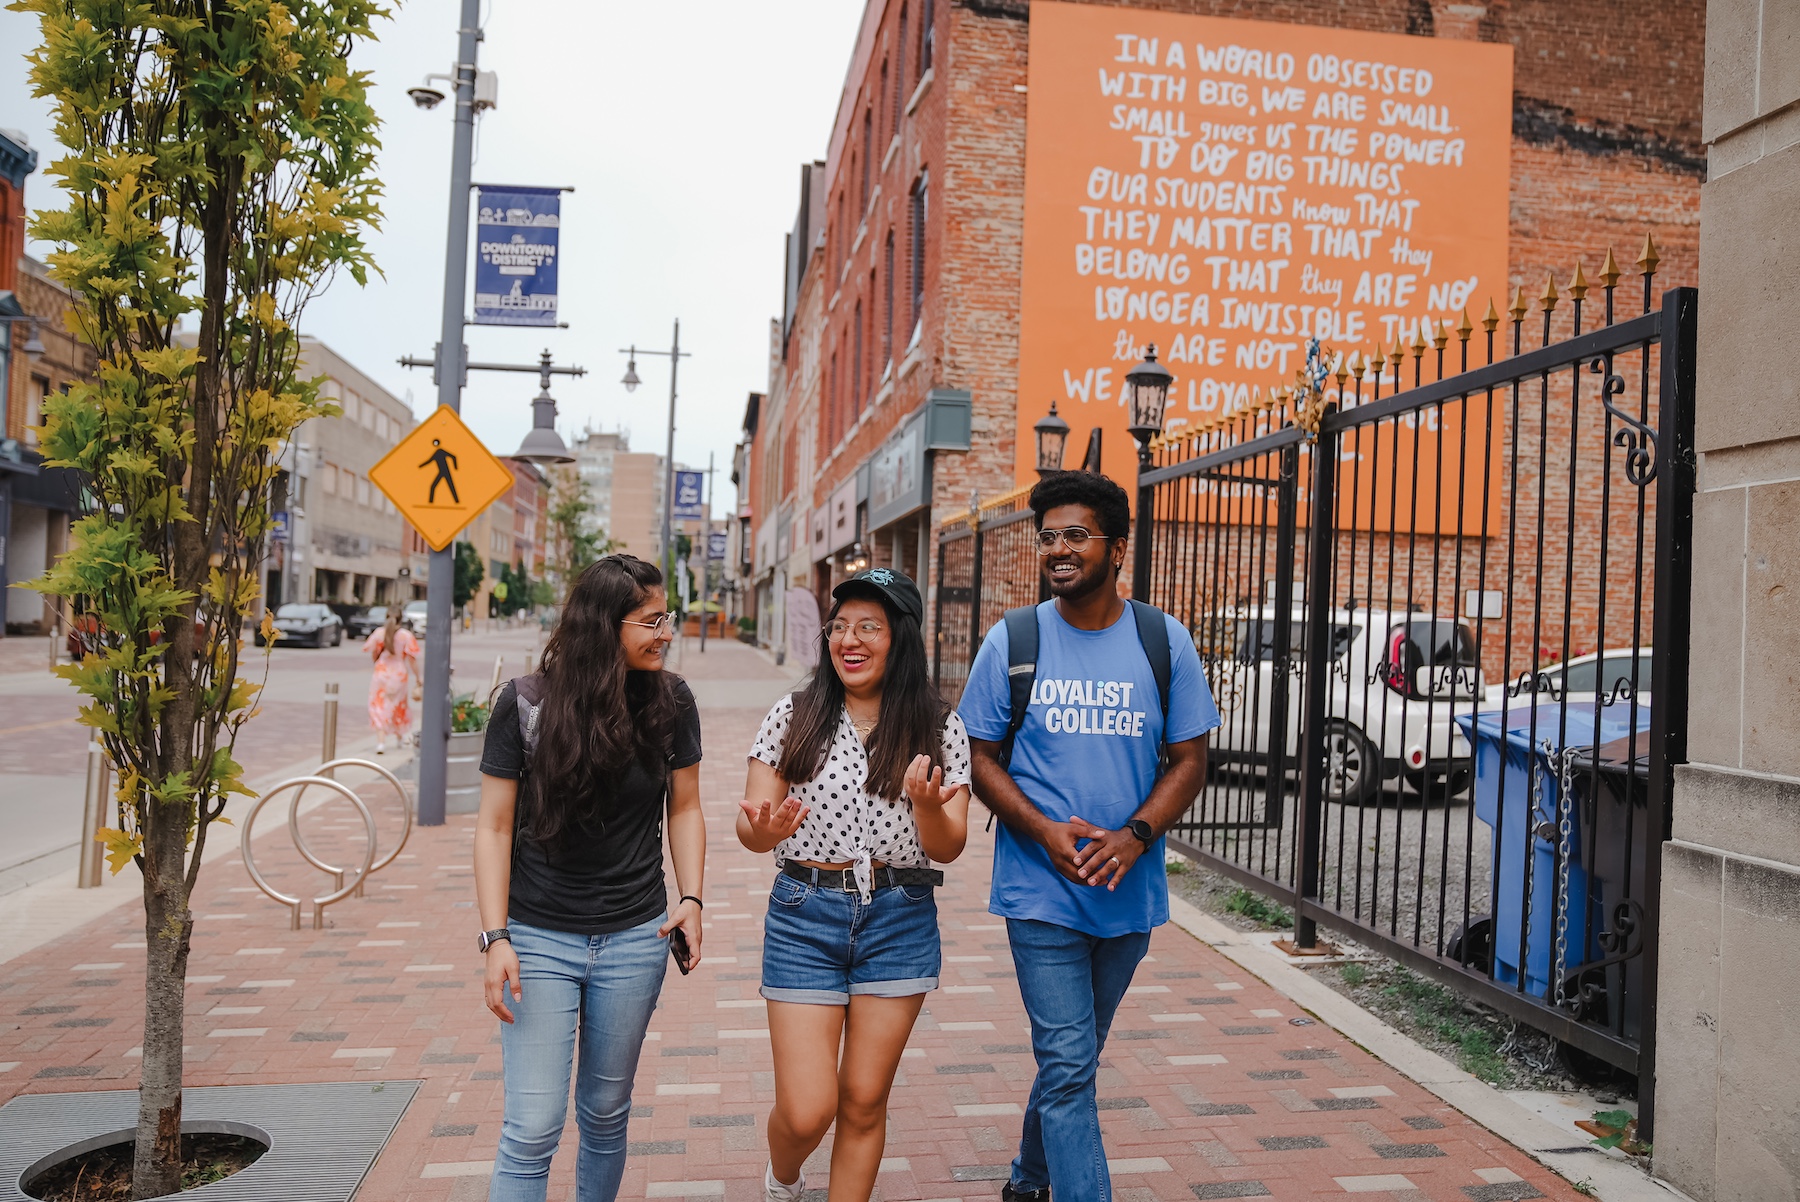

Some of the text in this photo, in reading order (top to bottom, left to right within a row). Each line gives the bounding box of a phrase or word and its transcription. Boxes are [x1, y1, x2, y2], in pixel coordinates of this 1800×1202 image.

[1114, 33, 1433, 97] IN A WORLD OBSESSED
[1098, 67, 1460, 134] WITH BIG, WE ARE SMALL.
[1109, 104, 1465, 167] SMALL gives US THE POWER
[1132, 135, 1410, 195] TO DO BIG THINGS.
[1087, 166, 1147, 206] OUR
[1153, 176, 1287, 216] STUDENTS
[1354, 193, 1420, 232] THAT
[480, 242, 556, 257] DOWNTOWN
[491, 254, 544, 267] DISTRICT
[1078, 205, 1433, 277] THEY MATTER THAT they
[1075, 243, 1478, 311] BELONG THAT they ARE NO
[1095, 285, 1209, 327] LONGER
[1218, 297, 1370, 344] INVISIBLE.
[1167, 332, 1227, 366] ARE
[1235, 338, 1298, 375] NOT
[1063, 366, 1113, 404] WE
[1045, 707, 1146, 738] COLLEGE
